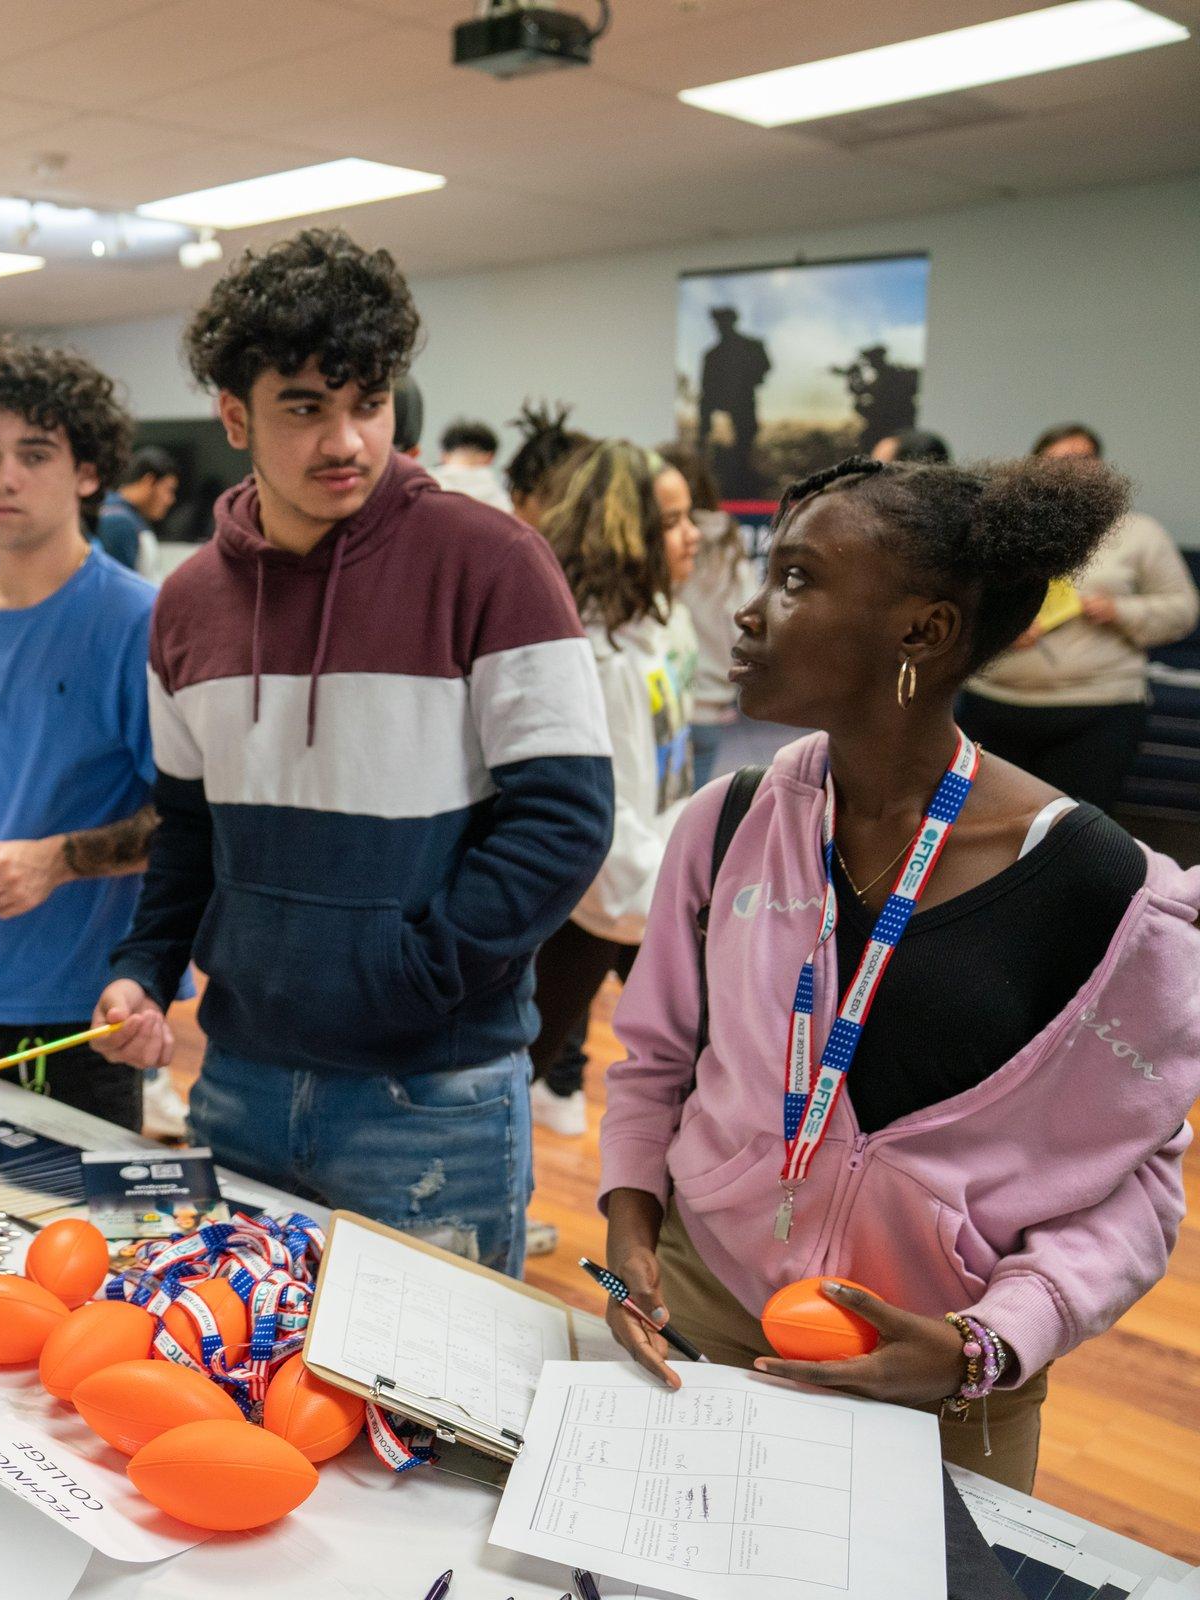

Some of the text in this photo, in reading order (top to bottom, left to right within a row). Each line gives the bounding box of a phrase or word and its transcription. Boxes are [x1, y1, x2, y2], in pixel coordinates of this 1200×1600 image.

[909, 841, 934, 871] FTC
[848, 945, 884, 1017] FTCCOLLEGE.EDU
[795, 1018, 805, 1092] FTCCOLLEGE.EDU
[810, 1089, 830, 1119] FTC
[12, 1441, 104, 1511] COLLEGE
